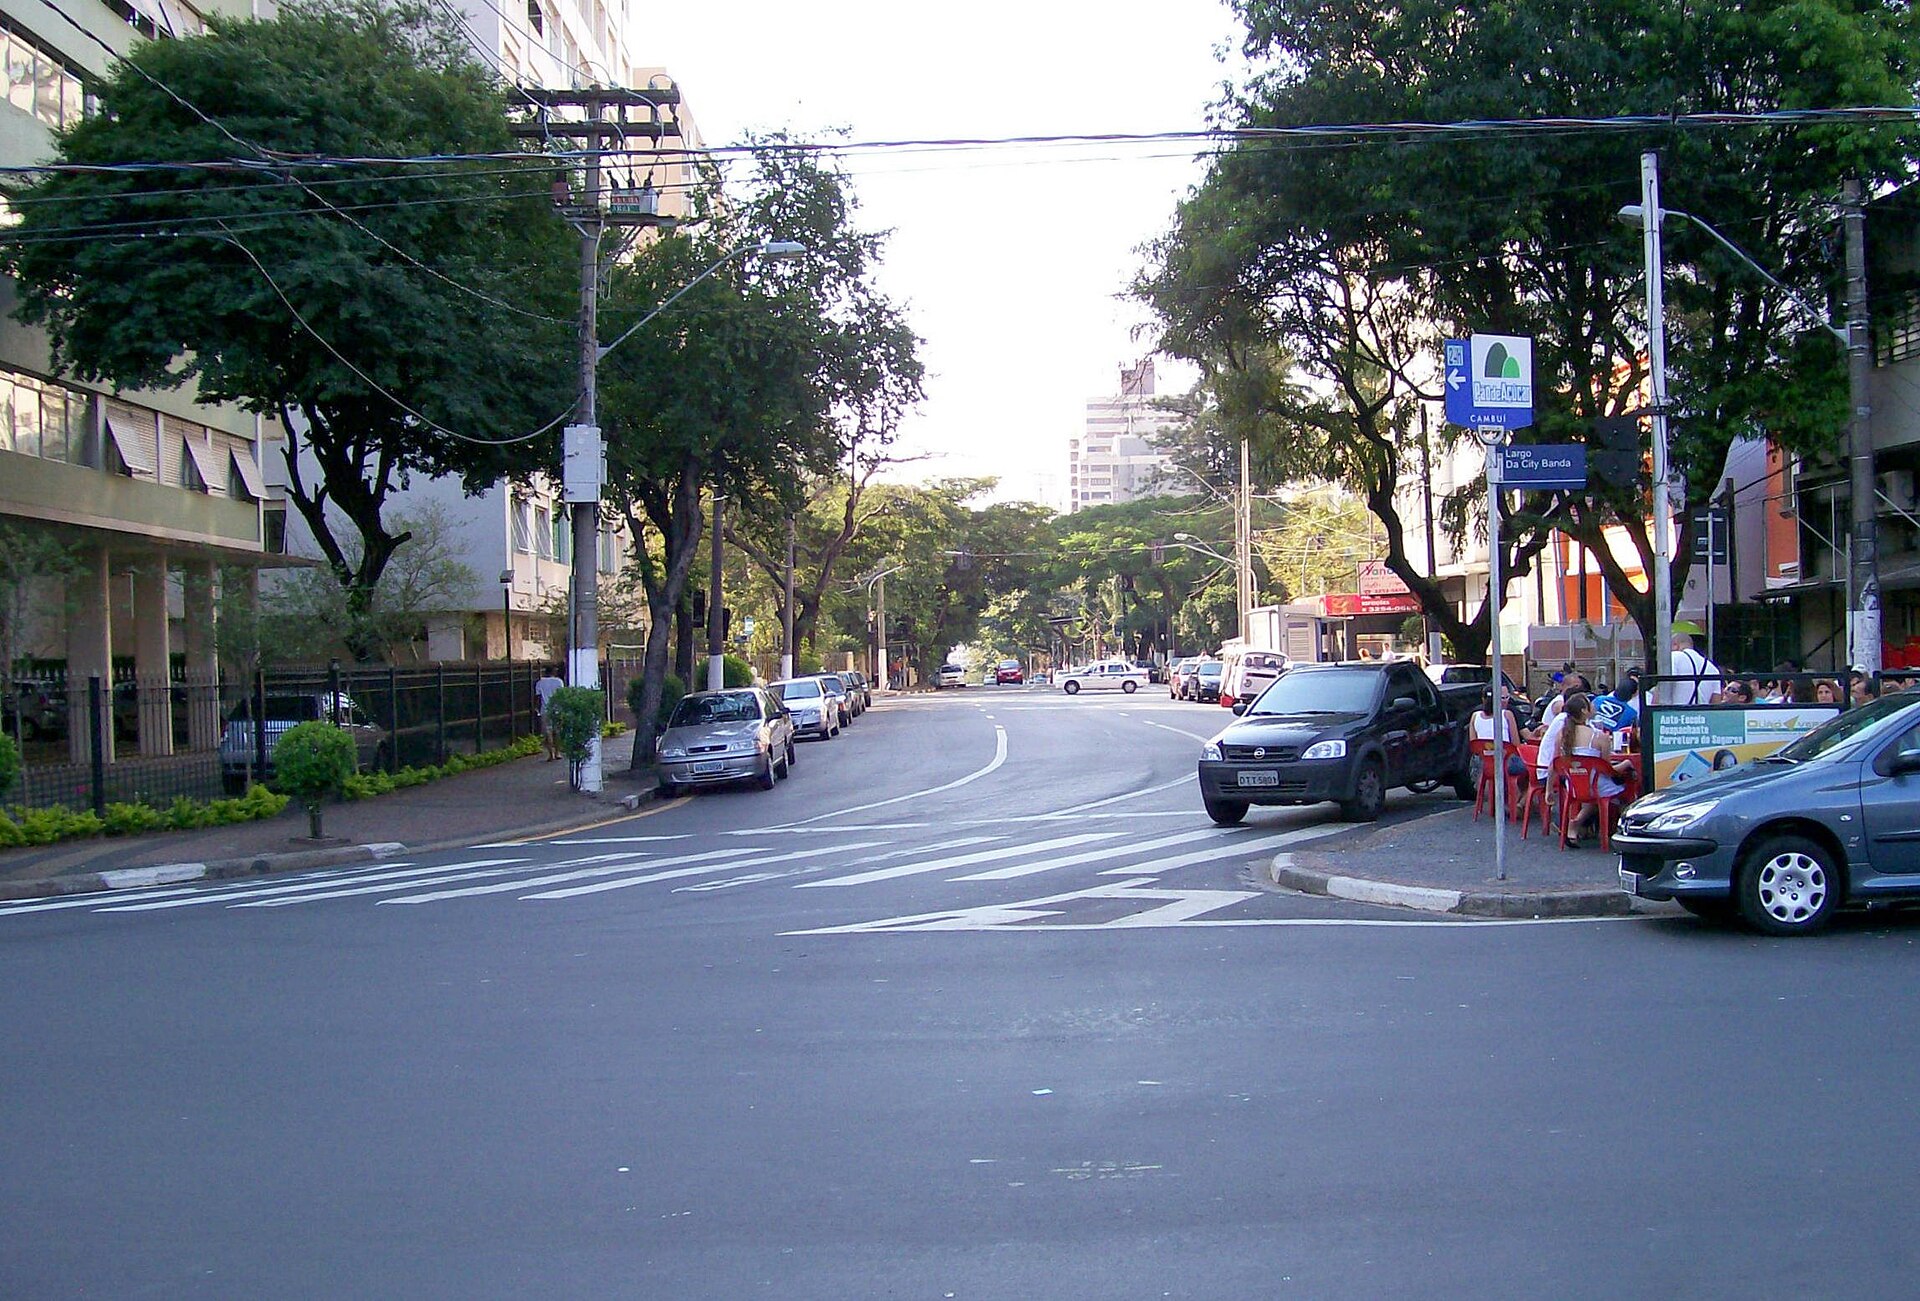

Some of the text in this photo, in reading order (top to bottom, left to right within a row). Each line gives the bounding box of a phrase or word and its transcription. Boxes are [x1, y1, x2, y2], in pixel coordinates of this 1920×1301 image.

[1470, 414, 1506, 423] CAMBUÍ
[1505, 449, 1532, 459] Largo
[1505, 459, 1571, 470] Da City Banda
